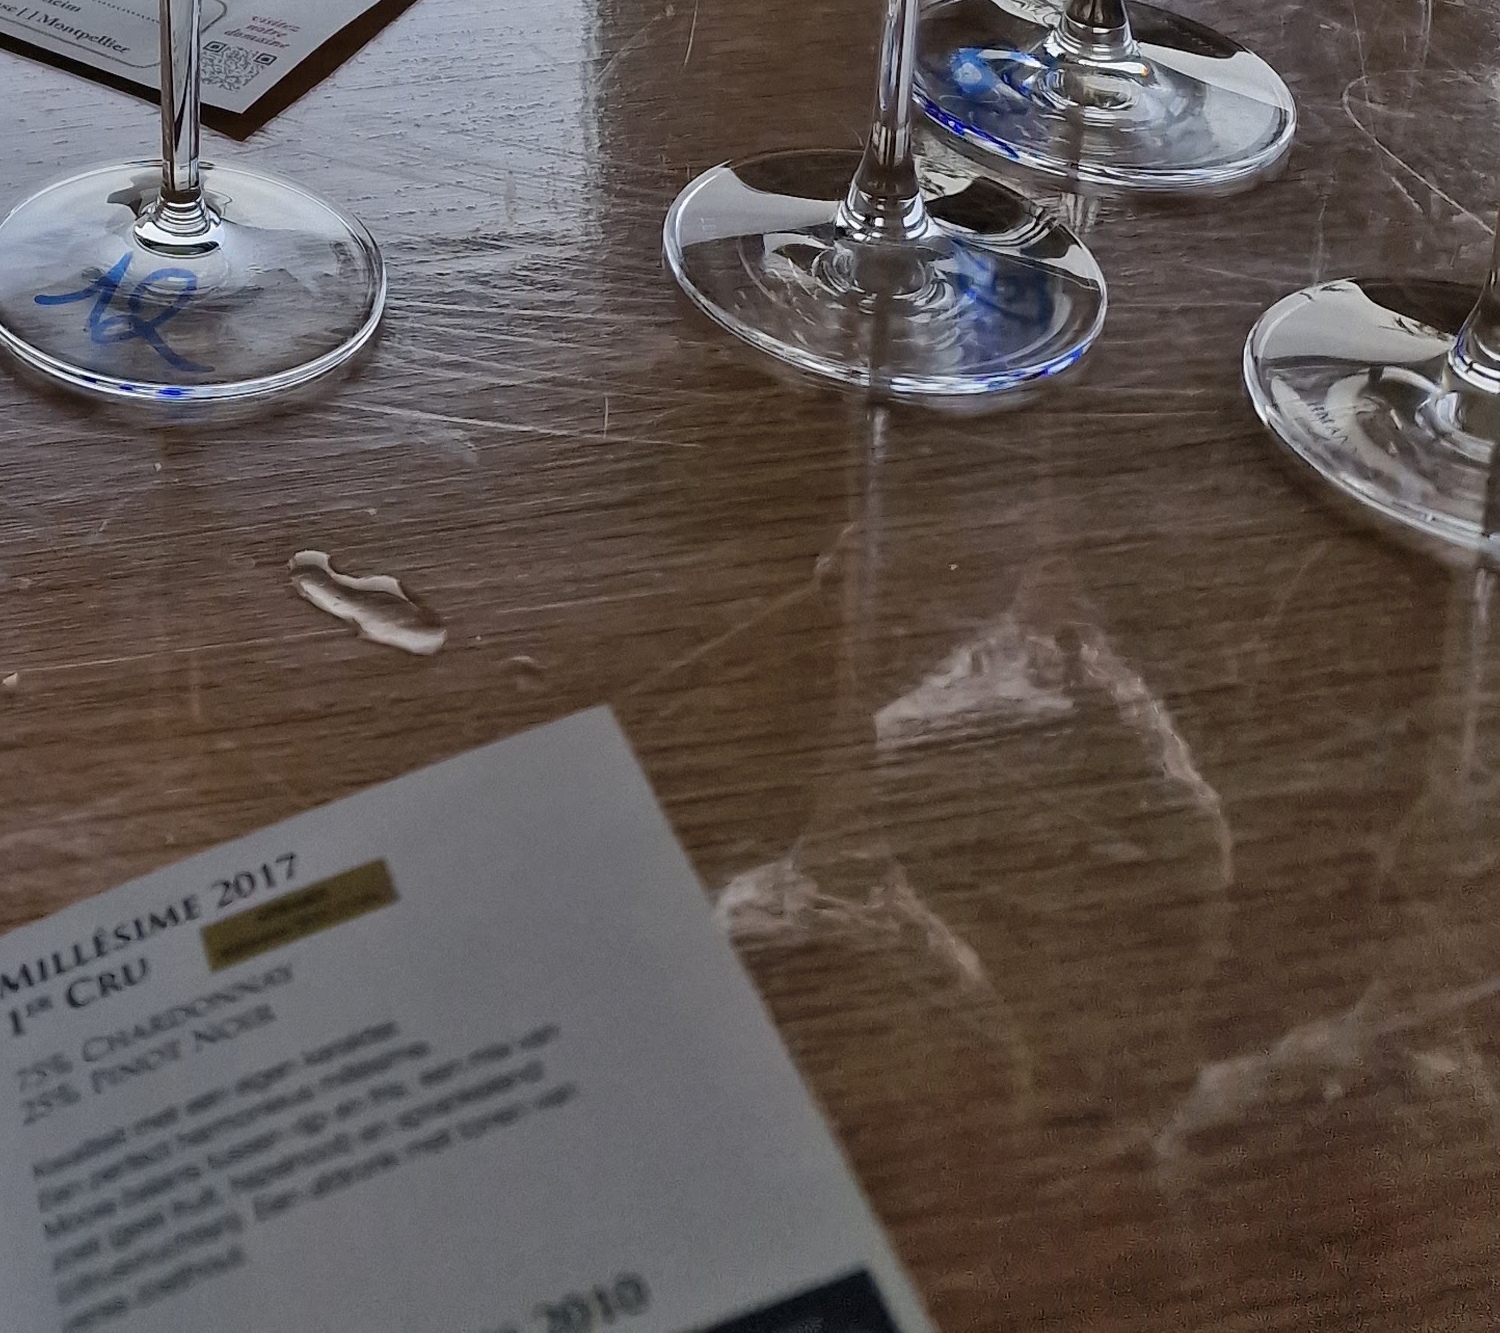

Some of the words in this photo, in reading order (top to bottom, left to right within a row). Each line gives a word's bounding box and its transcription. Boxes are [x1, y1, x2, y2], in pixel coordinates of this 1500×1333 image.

[37, 13, 131, 54] Montpellier
[0, 892, 201, 999] MILLÉSIME
[211, 852, 297, 910] 2017
[65, 956, 150, 1009] CRU
[81, 963, 294, 1063] CHARDONNAY
[91, 1037, 182, 1095] PINOT
[193, 1002, 277, 1051] NOIR
